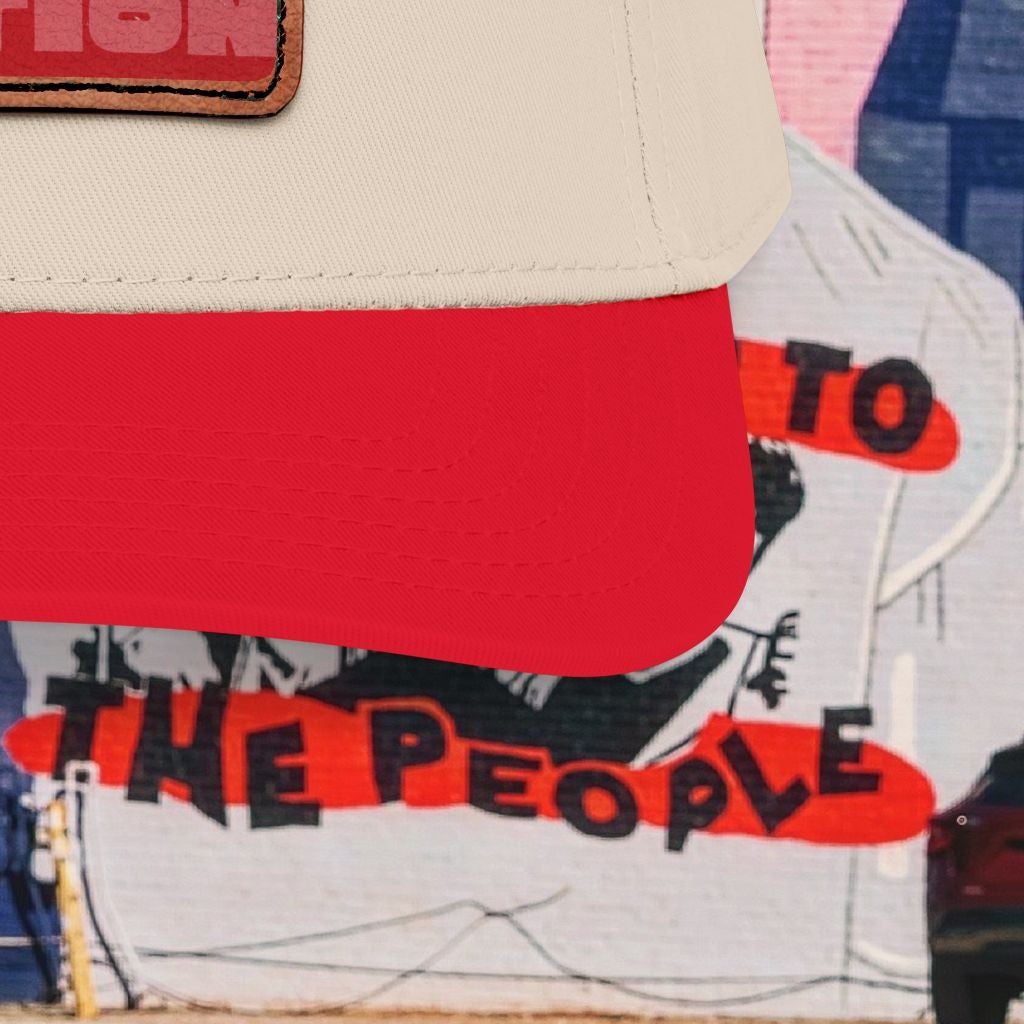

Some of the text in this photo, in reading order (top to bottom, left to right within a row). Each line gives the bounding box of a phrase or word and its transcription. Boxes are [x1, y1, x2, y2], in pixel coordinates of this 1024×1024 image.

[784, 338, 934, 455] TO
[46, 674, 883, 852] THE PEOPLE
